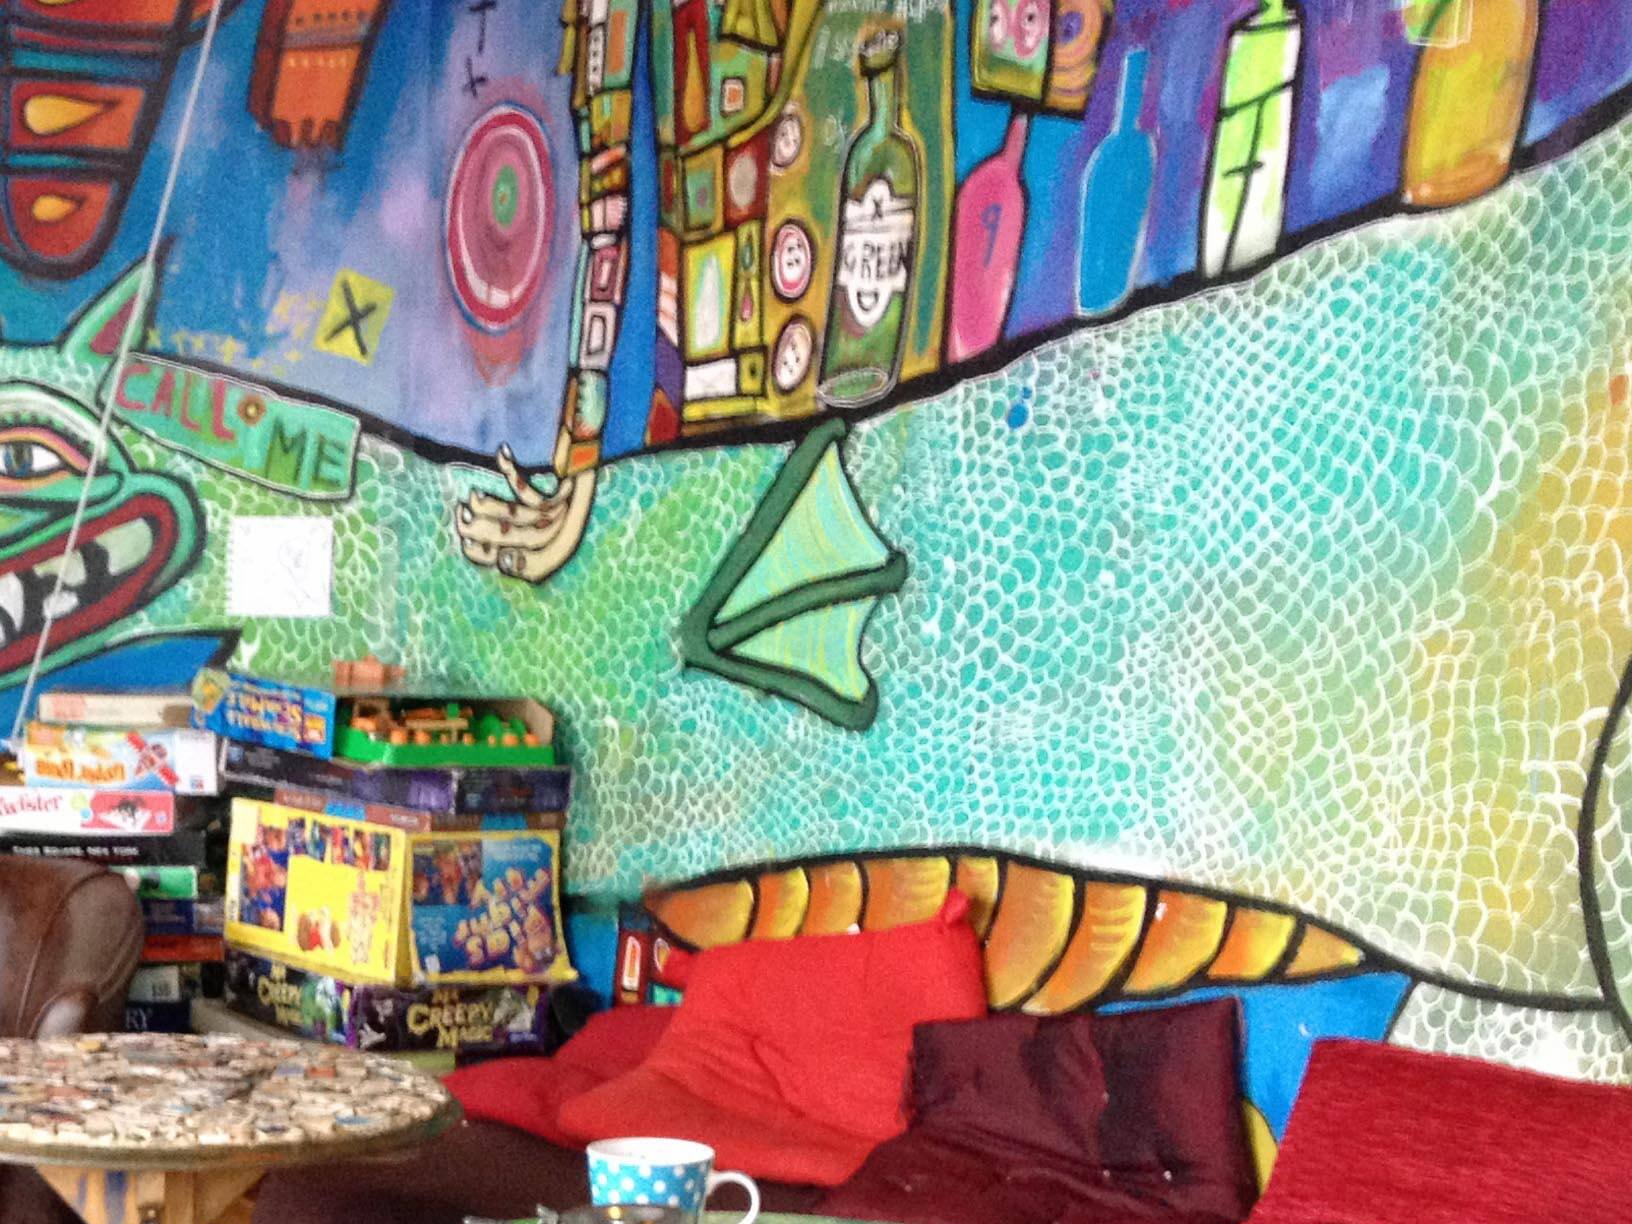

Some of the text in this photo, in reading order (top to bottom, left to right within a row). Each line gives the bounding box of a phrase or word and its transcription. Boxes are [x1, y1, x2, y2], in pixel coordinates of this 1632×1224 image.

[114, 363, 347, 490] CALL ME
[406, 1002, 493, 1036] CREEPY
